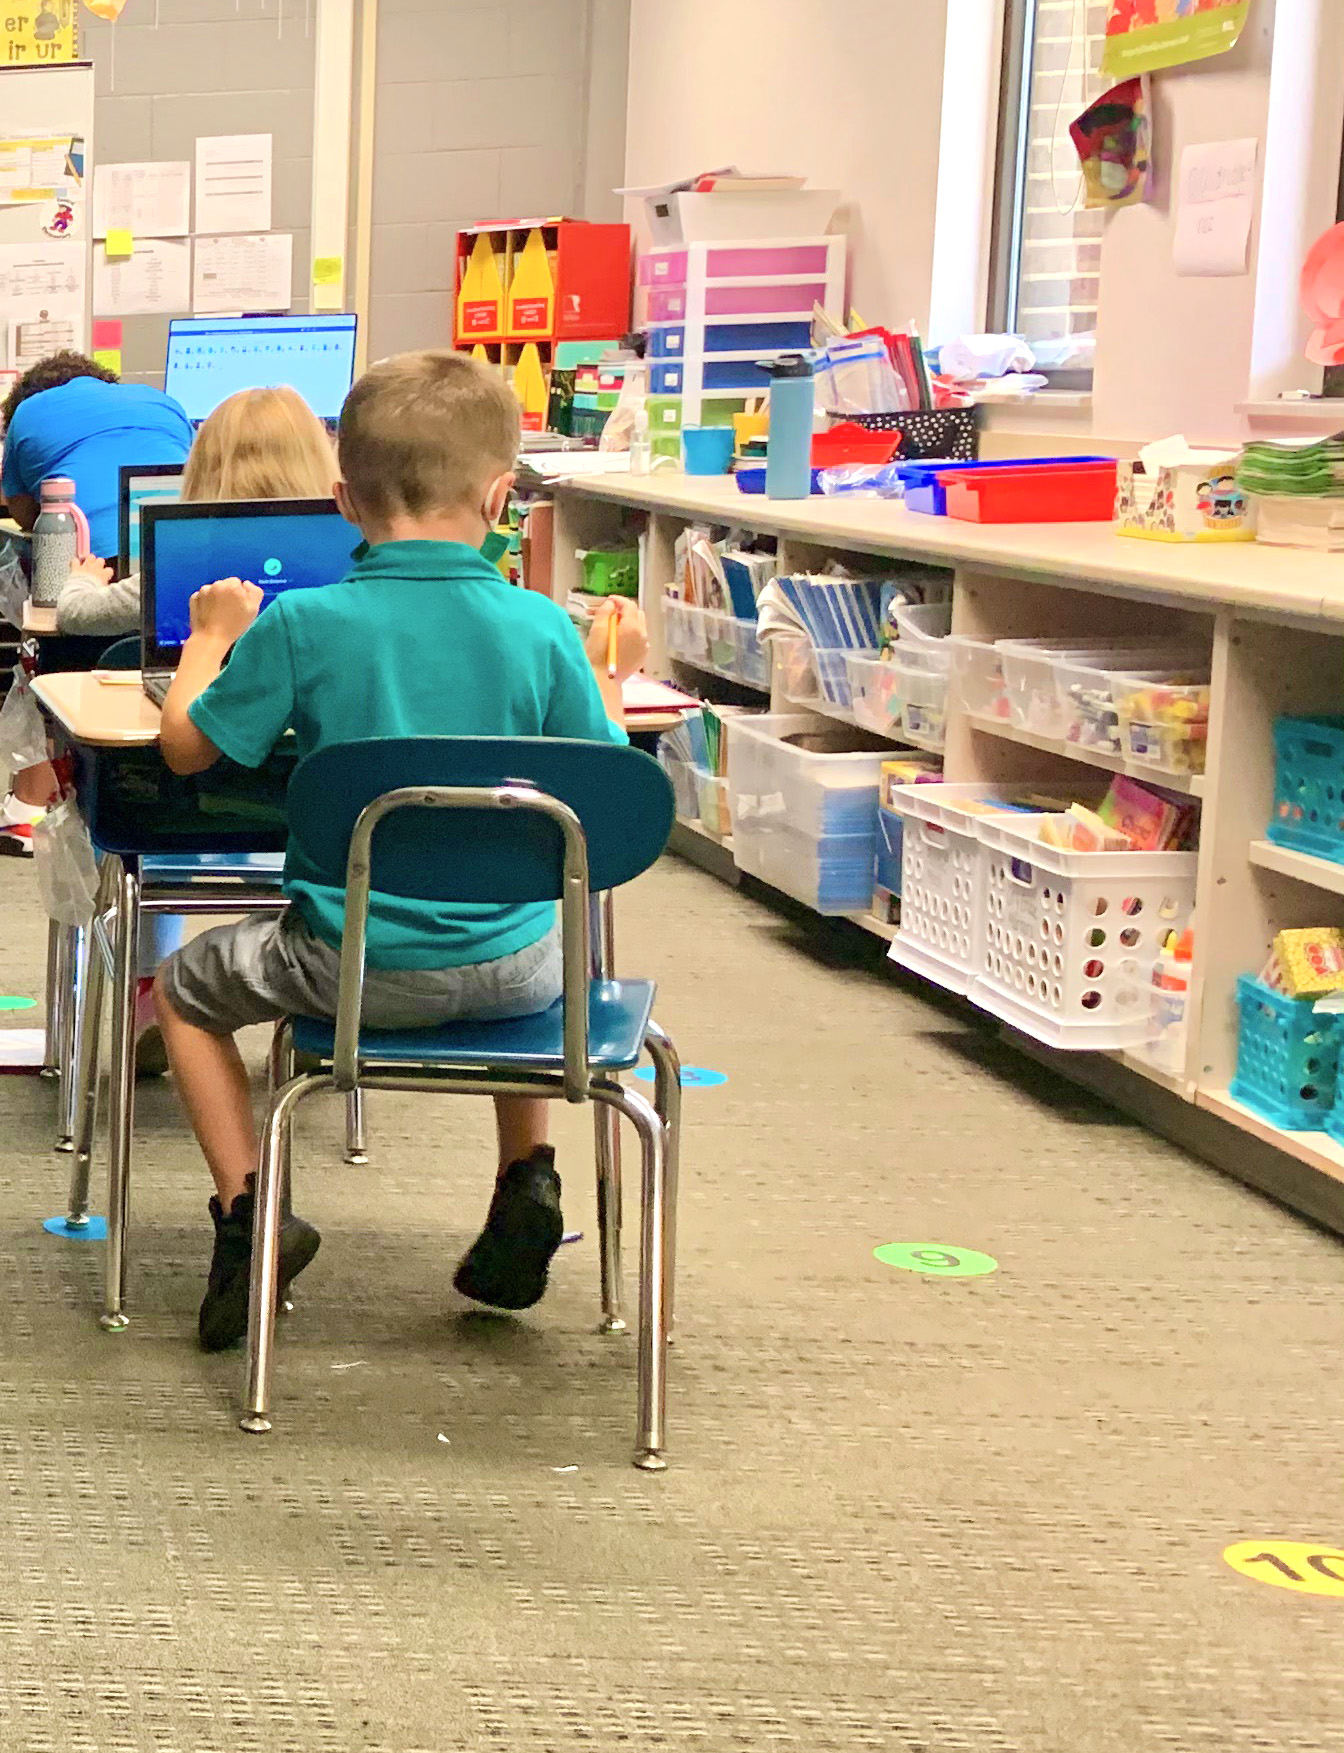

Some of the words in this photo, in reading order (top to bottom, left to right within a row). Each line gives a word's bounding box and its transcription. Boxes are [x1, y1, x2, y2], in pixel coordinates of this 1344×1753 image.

[5, 15, 29, 32] er
[8, 40, 26, 60] ir
[36, 42, 62, 59] ur
[912, 1250, 960, 1267] 9
